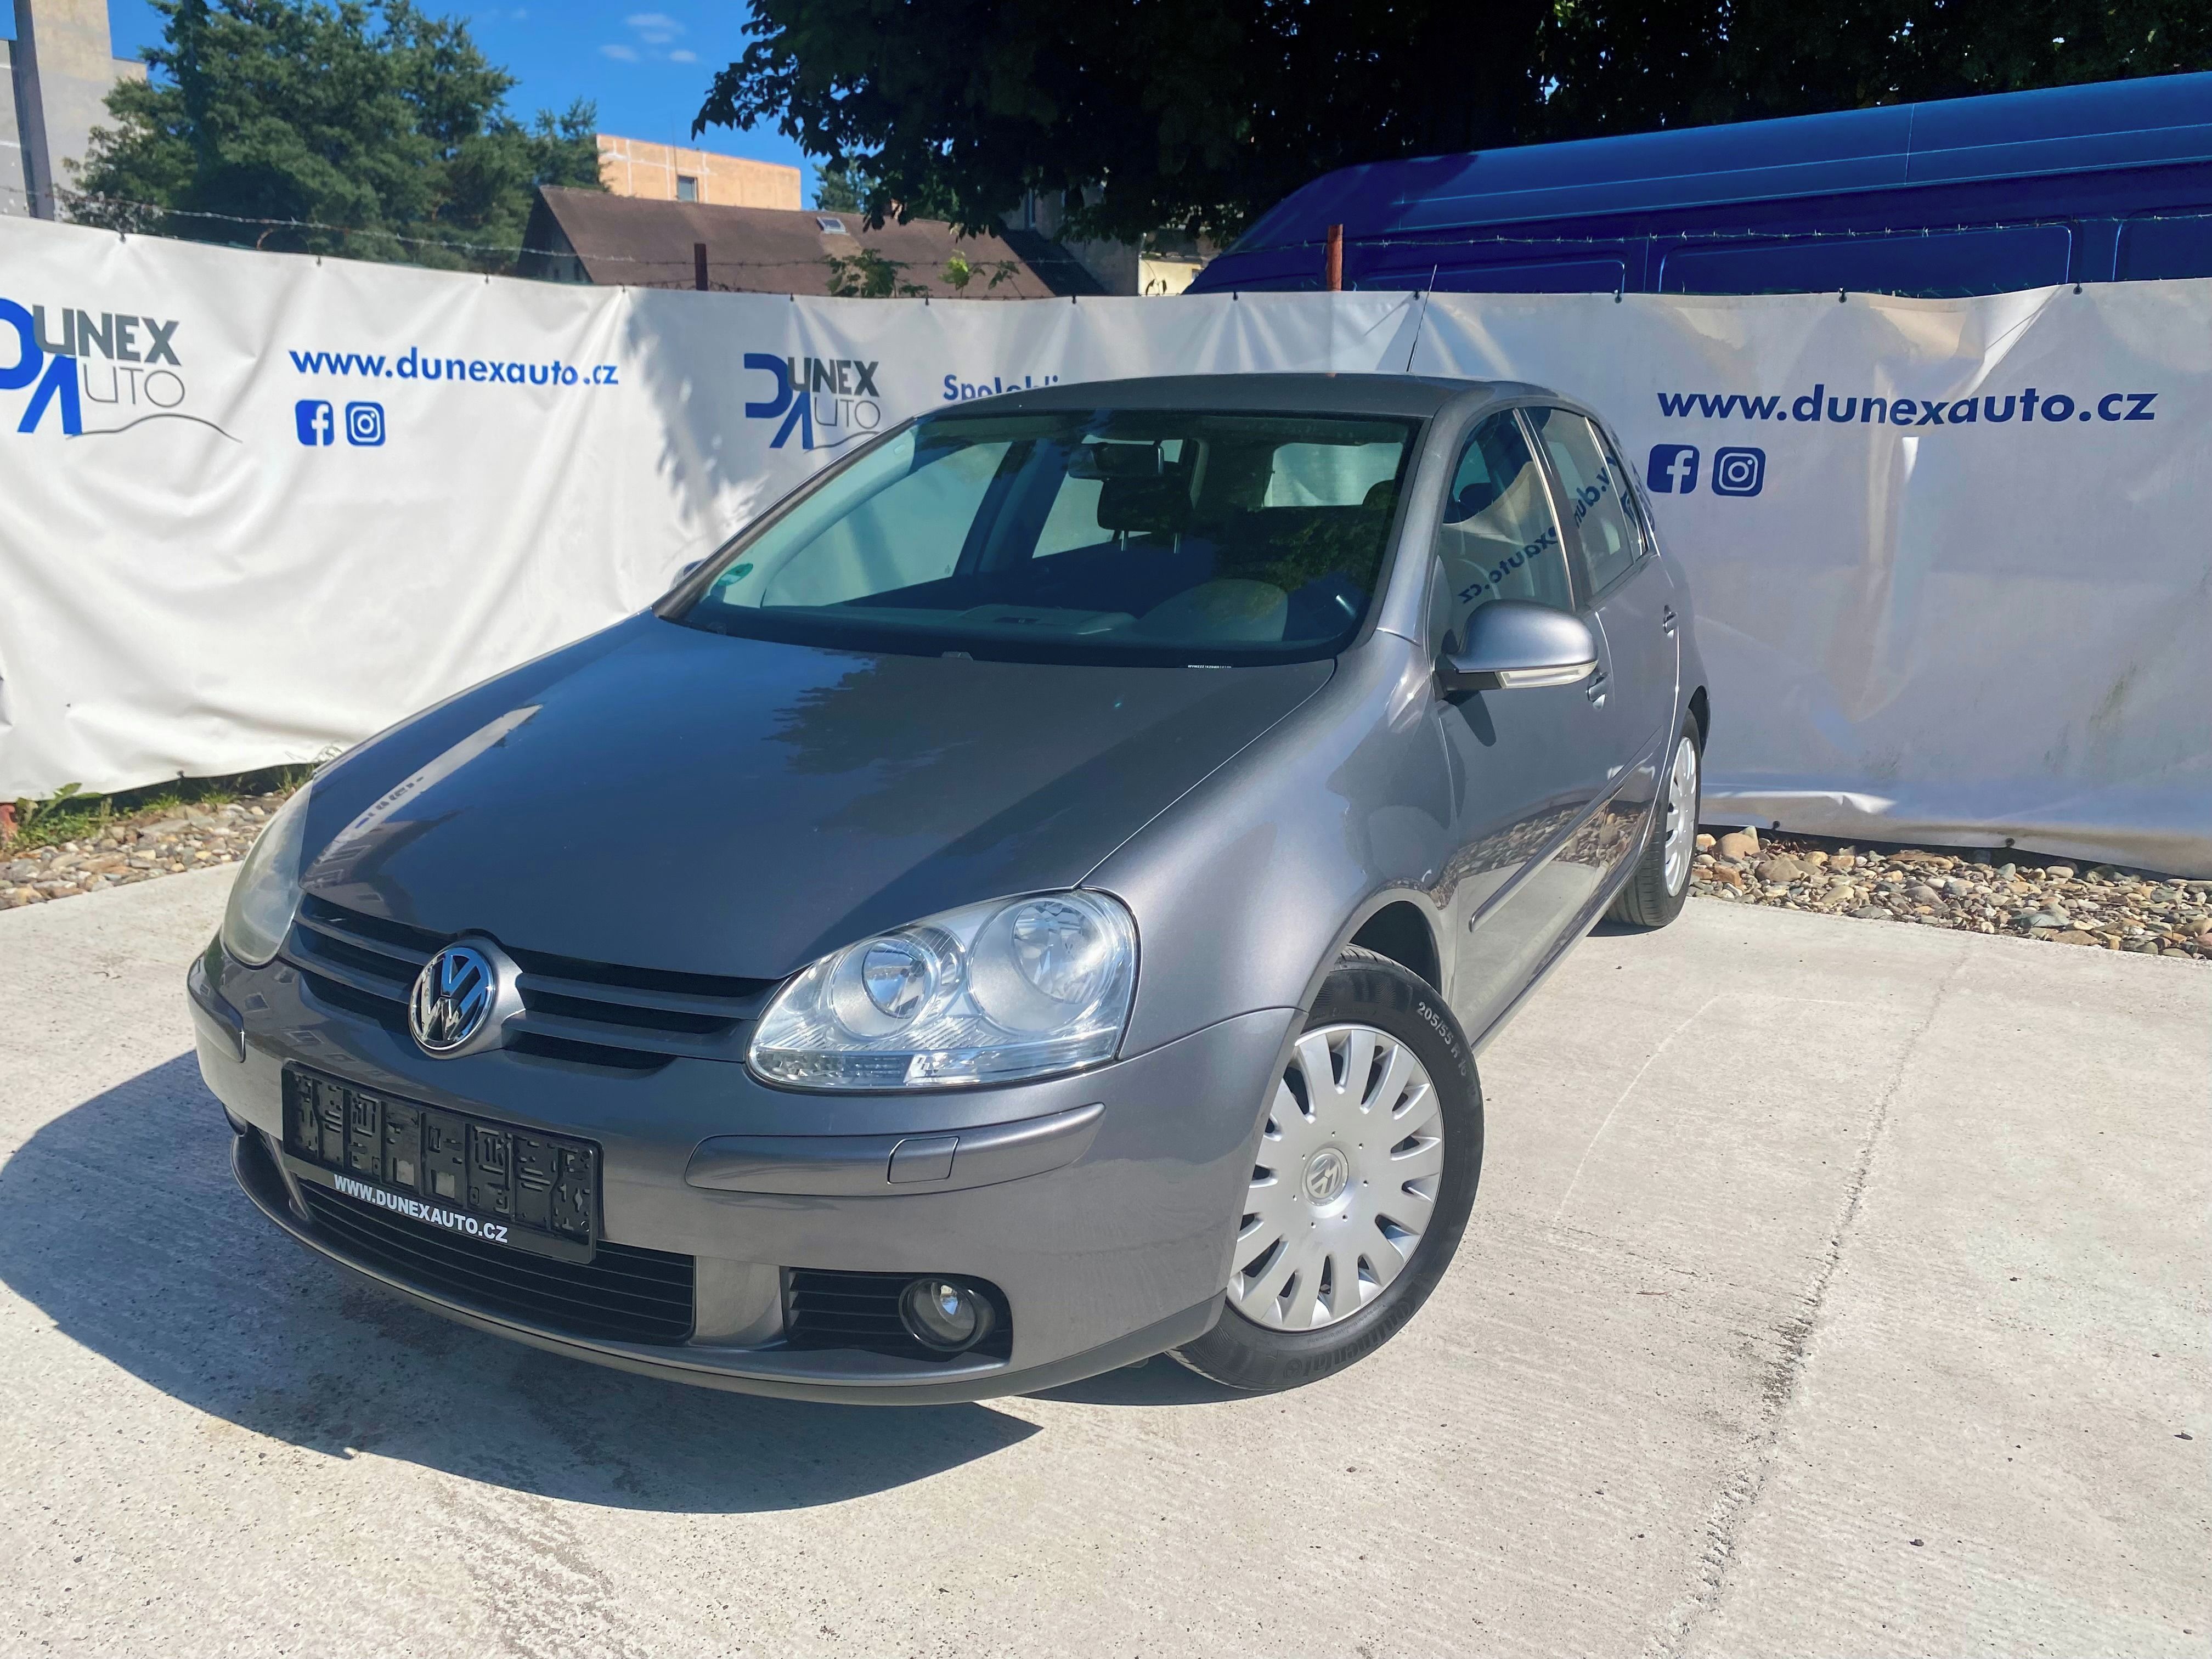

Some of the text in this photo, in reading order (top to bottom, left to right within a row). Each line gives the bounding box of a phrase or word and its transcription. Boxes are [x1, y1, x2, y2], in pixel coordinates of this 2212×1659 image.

[17, 354, 185, 435] AUTO
[289, 347, 618, 385] www.dunexauto.cz
[744, 353, 879, 418] DUNEX
[769, 392, 881, 450] AUTO
[1657, 385, 2159, 425] www.dunexauto.cz
[1417, 1001, 1453, 1045] 205/55
[334, 1174, 508, 1243] WWW.DUNEXAUTO.CZ
